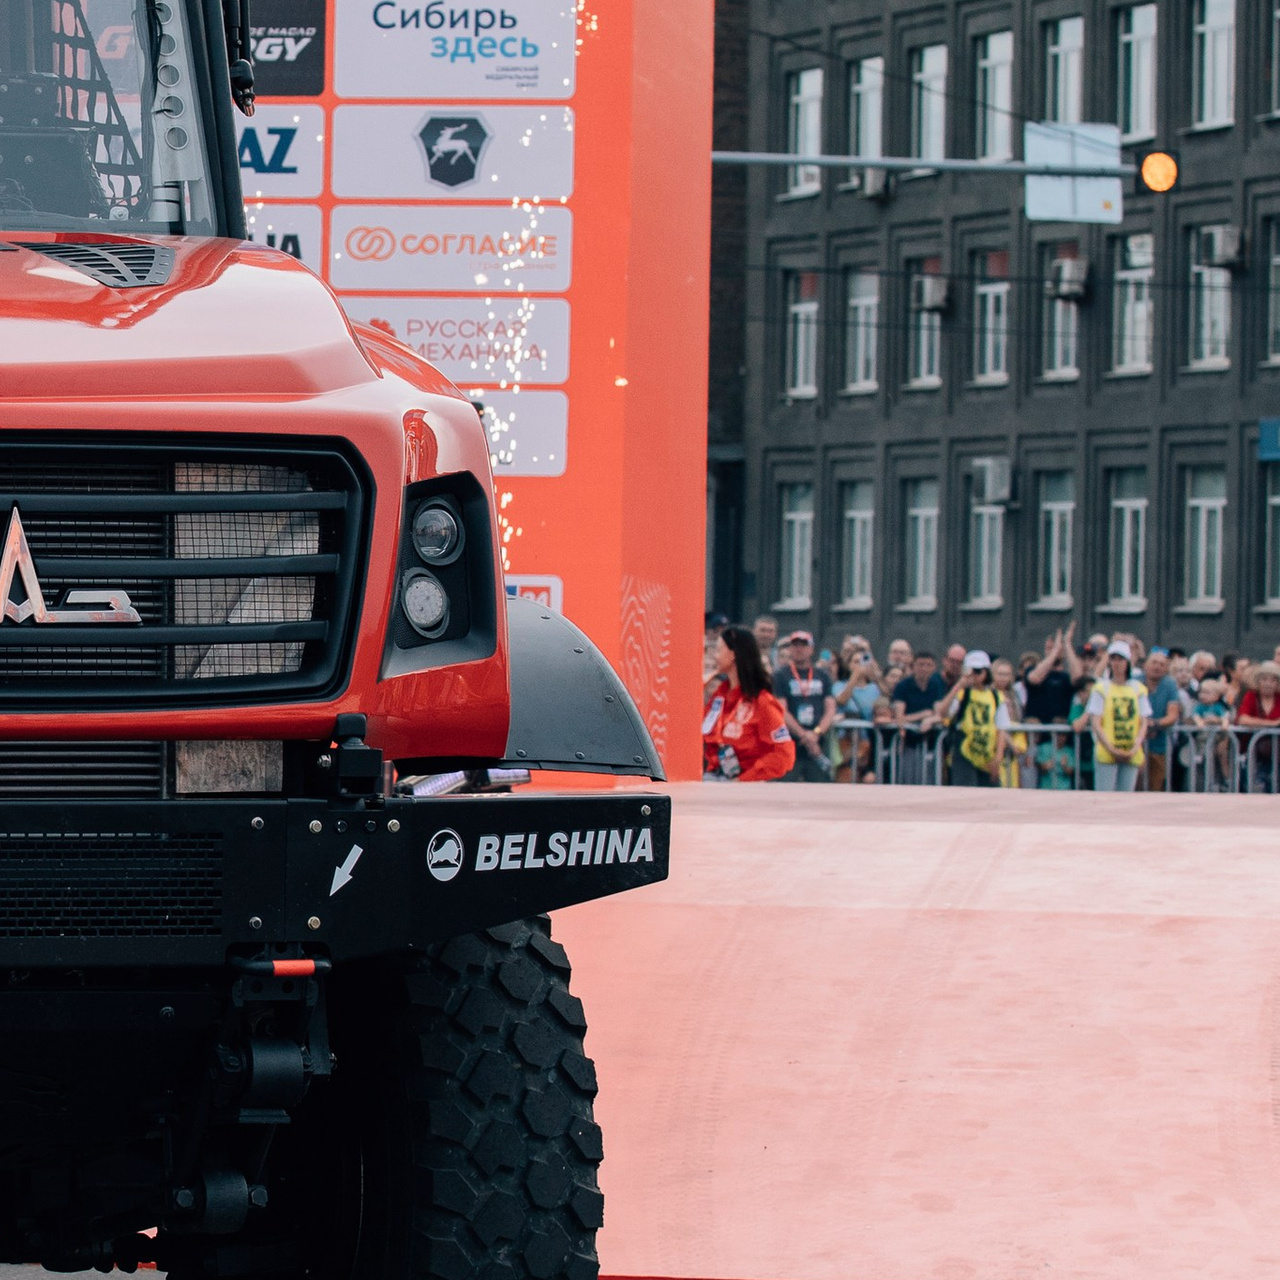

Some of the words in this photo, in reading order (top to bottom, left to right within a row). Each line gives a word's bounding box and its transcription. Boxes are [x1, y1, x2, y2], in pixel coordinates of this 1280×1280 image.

[372, 0, 518, 36] Сибирь
[430, 35, 540, 63] здесь
[401, 234, 558, 256] СОГЛАСИЕ
[406, 319, 526, 338] РУССКАЯ
[475, 827, 654, 872] BELSHINA
